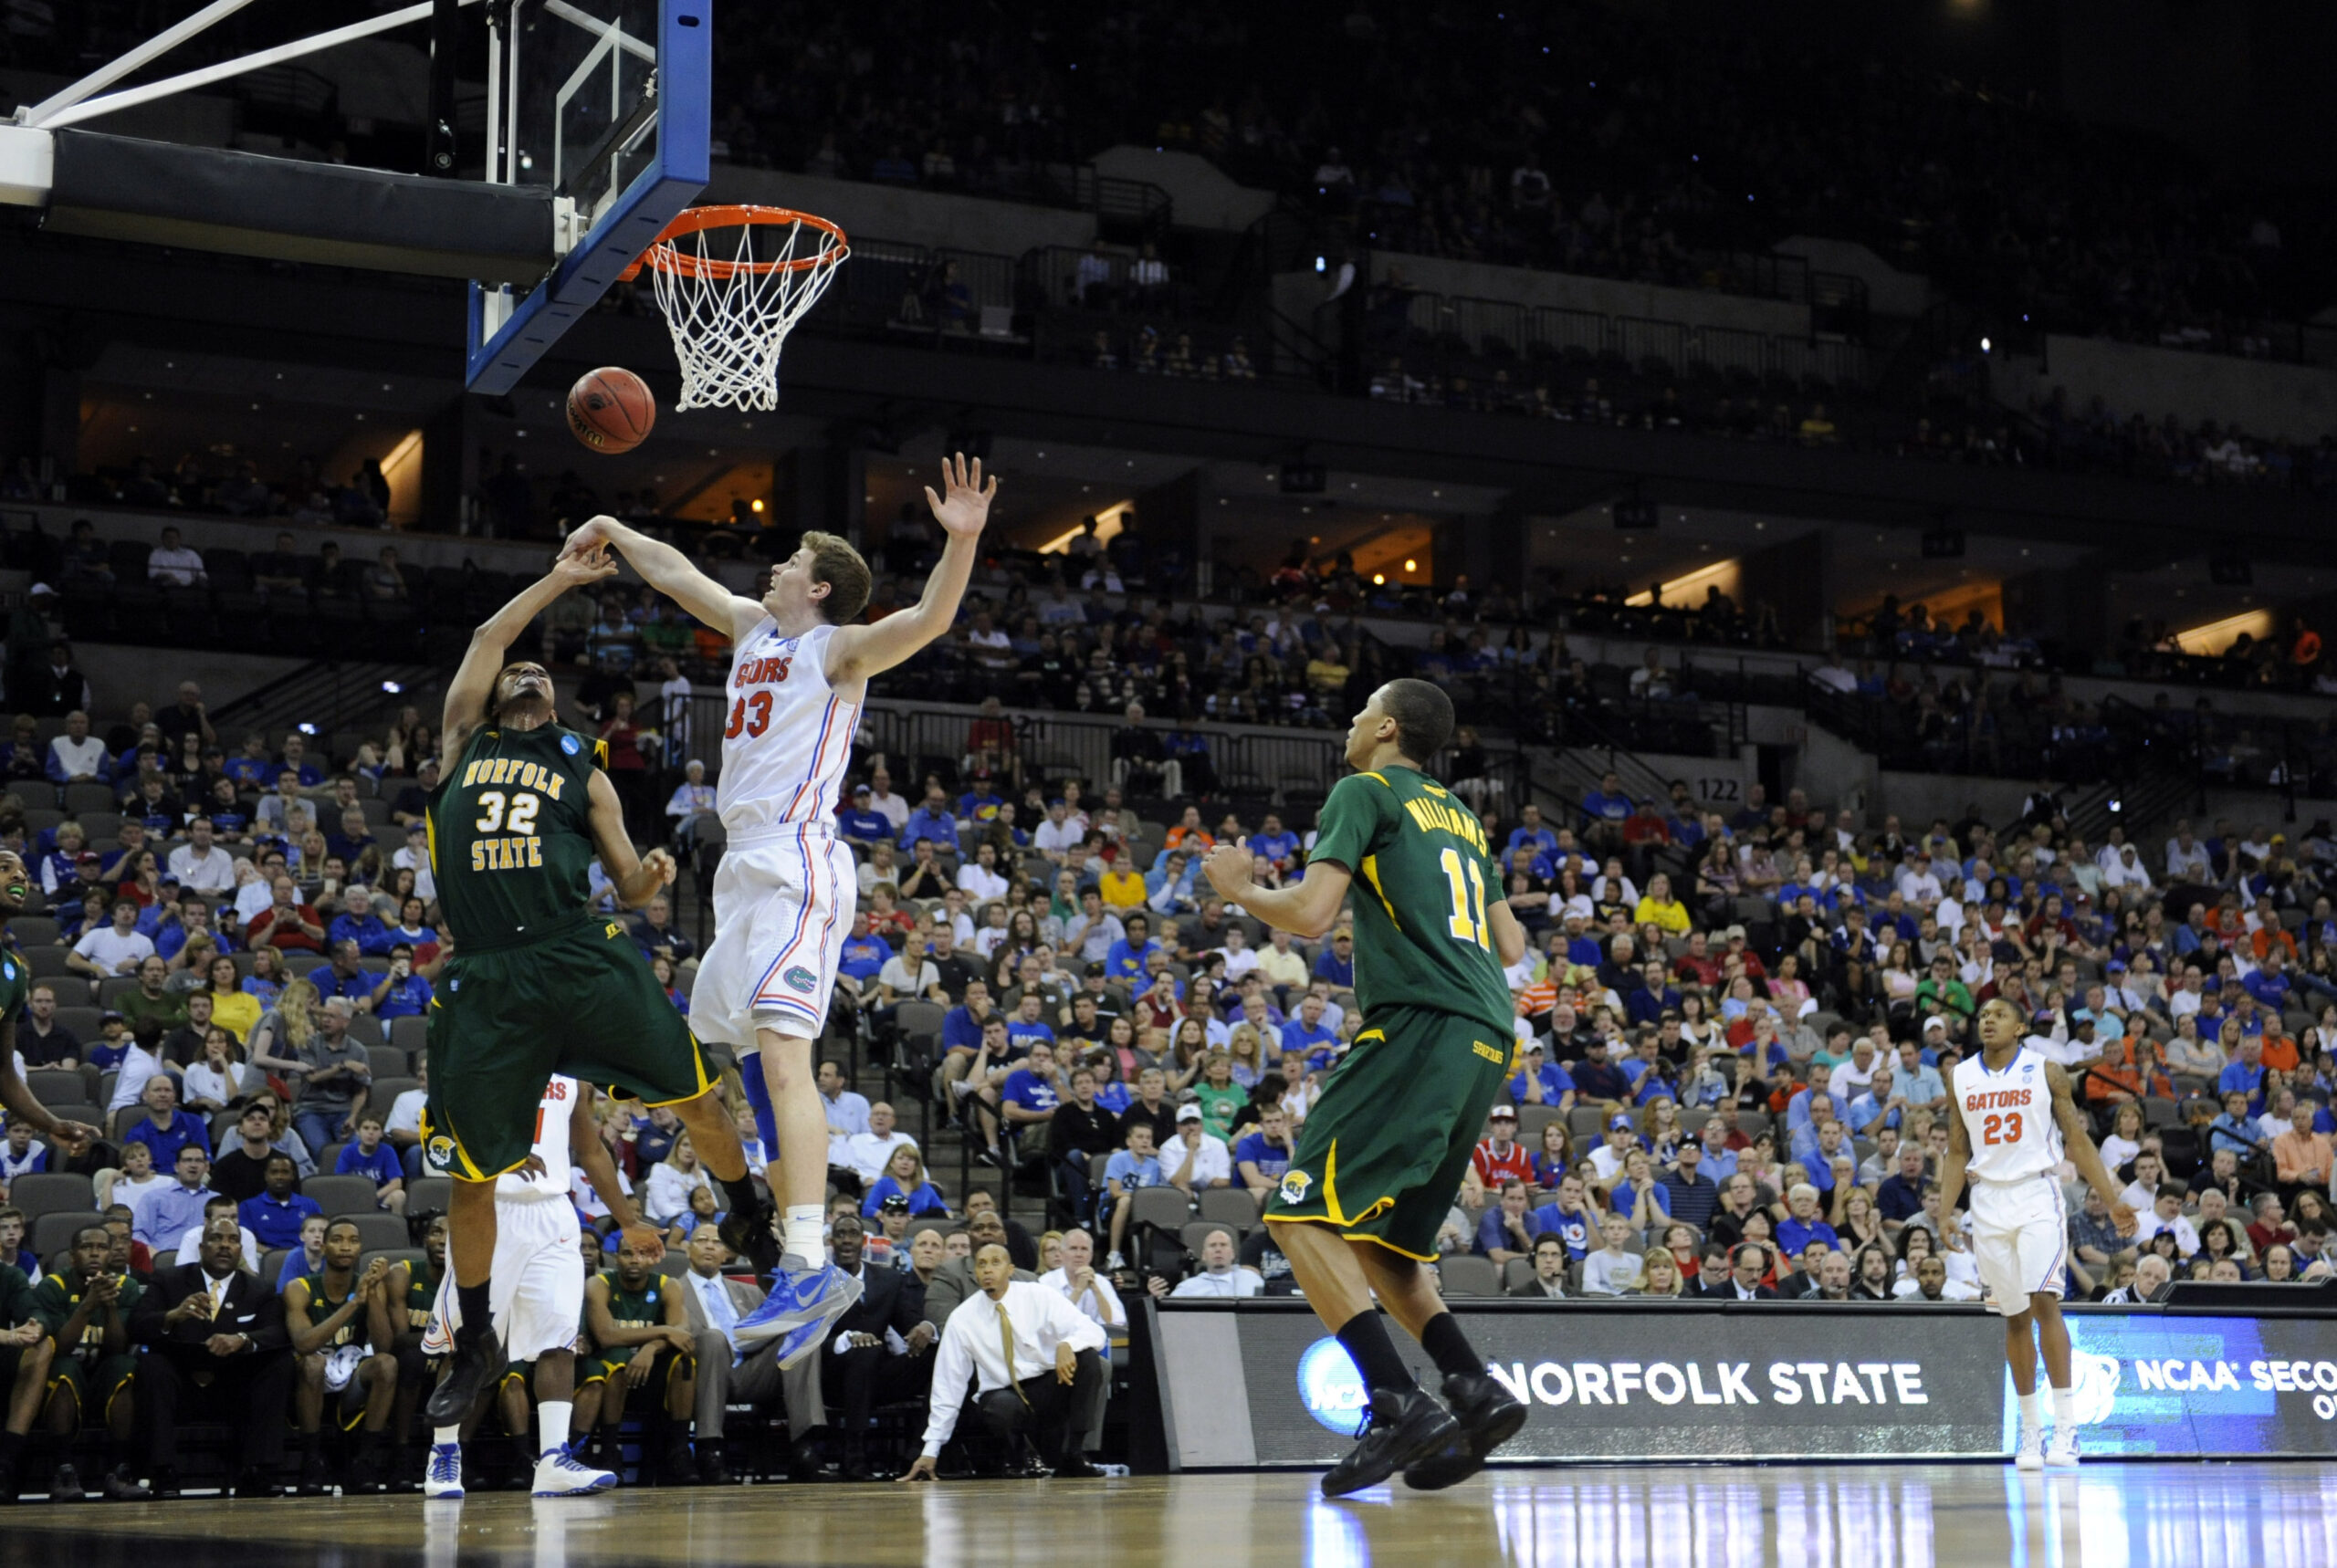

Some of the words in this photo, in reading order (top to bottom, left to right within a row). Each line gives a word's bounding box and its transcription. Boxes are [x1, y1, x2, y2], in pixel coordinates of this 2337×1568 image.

[462, 758, 565, 801] NORFOLK
[1698, 778, 1739, 800] 122
[476, 791, 540, 835] 32
[1404, 798, 1488, 858] WILLIAMS
[472, 837, 542, 872] STATE
[1440, 847, 1491, 954] 11
[1966, 1089, 2032, 1112] GATORS
[1984, 1112, 2023, 1145] 23
[1487, 1361, 1760, 1406] NORFOLK
[1768, 1362, 1929, 1405] STATE
[2249, 1360, 2337, 1392] SECO
